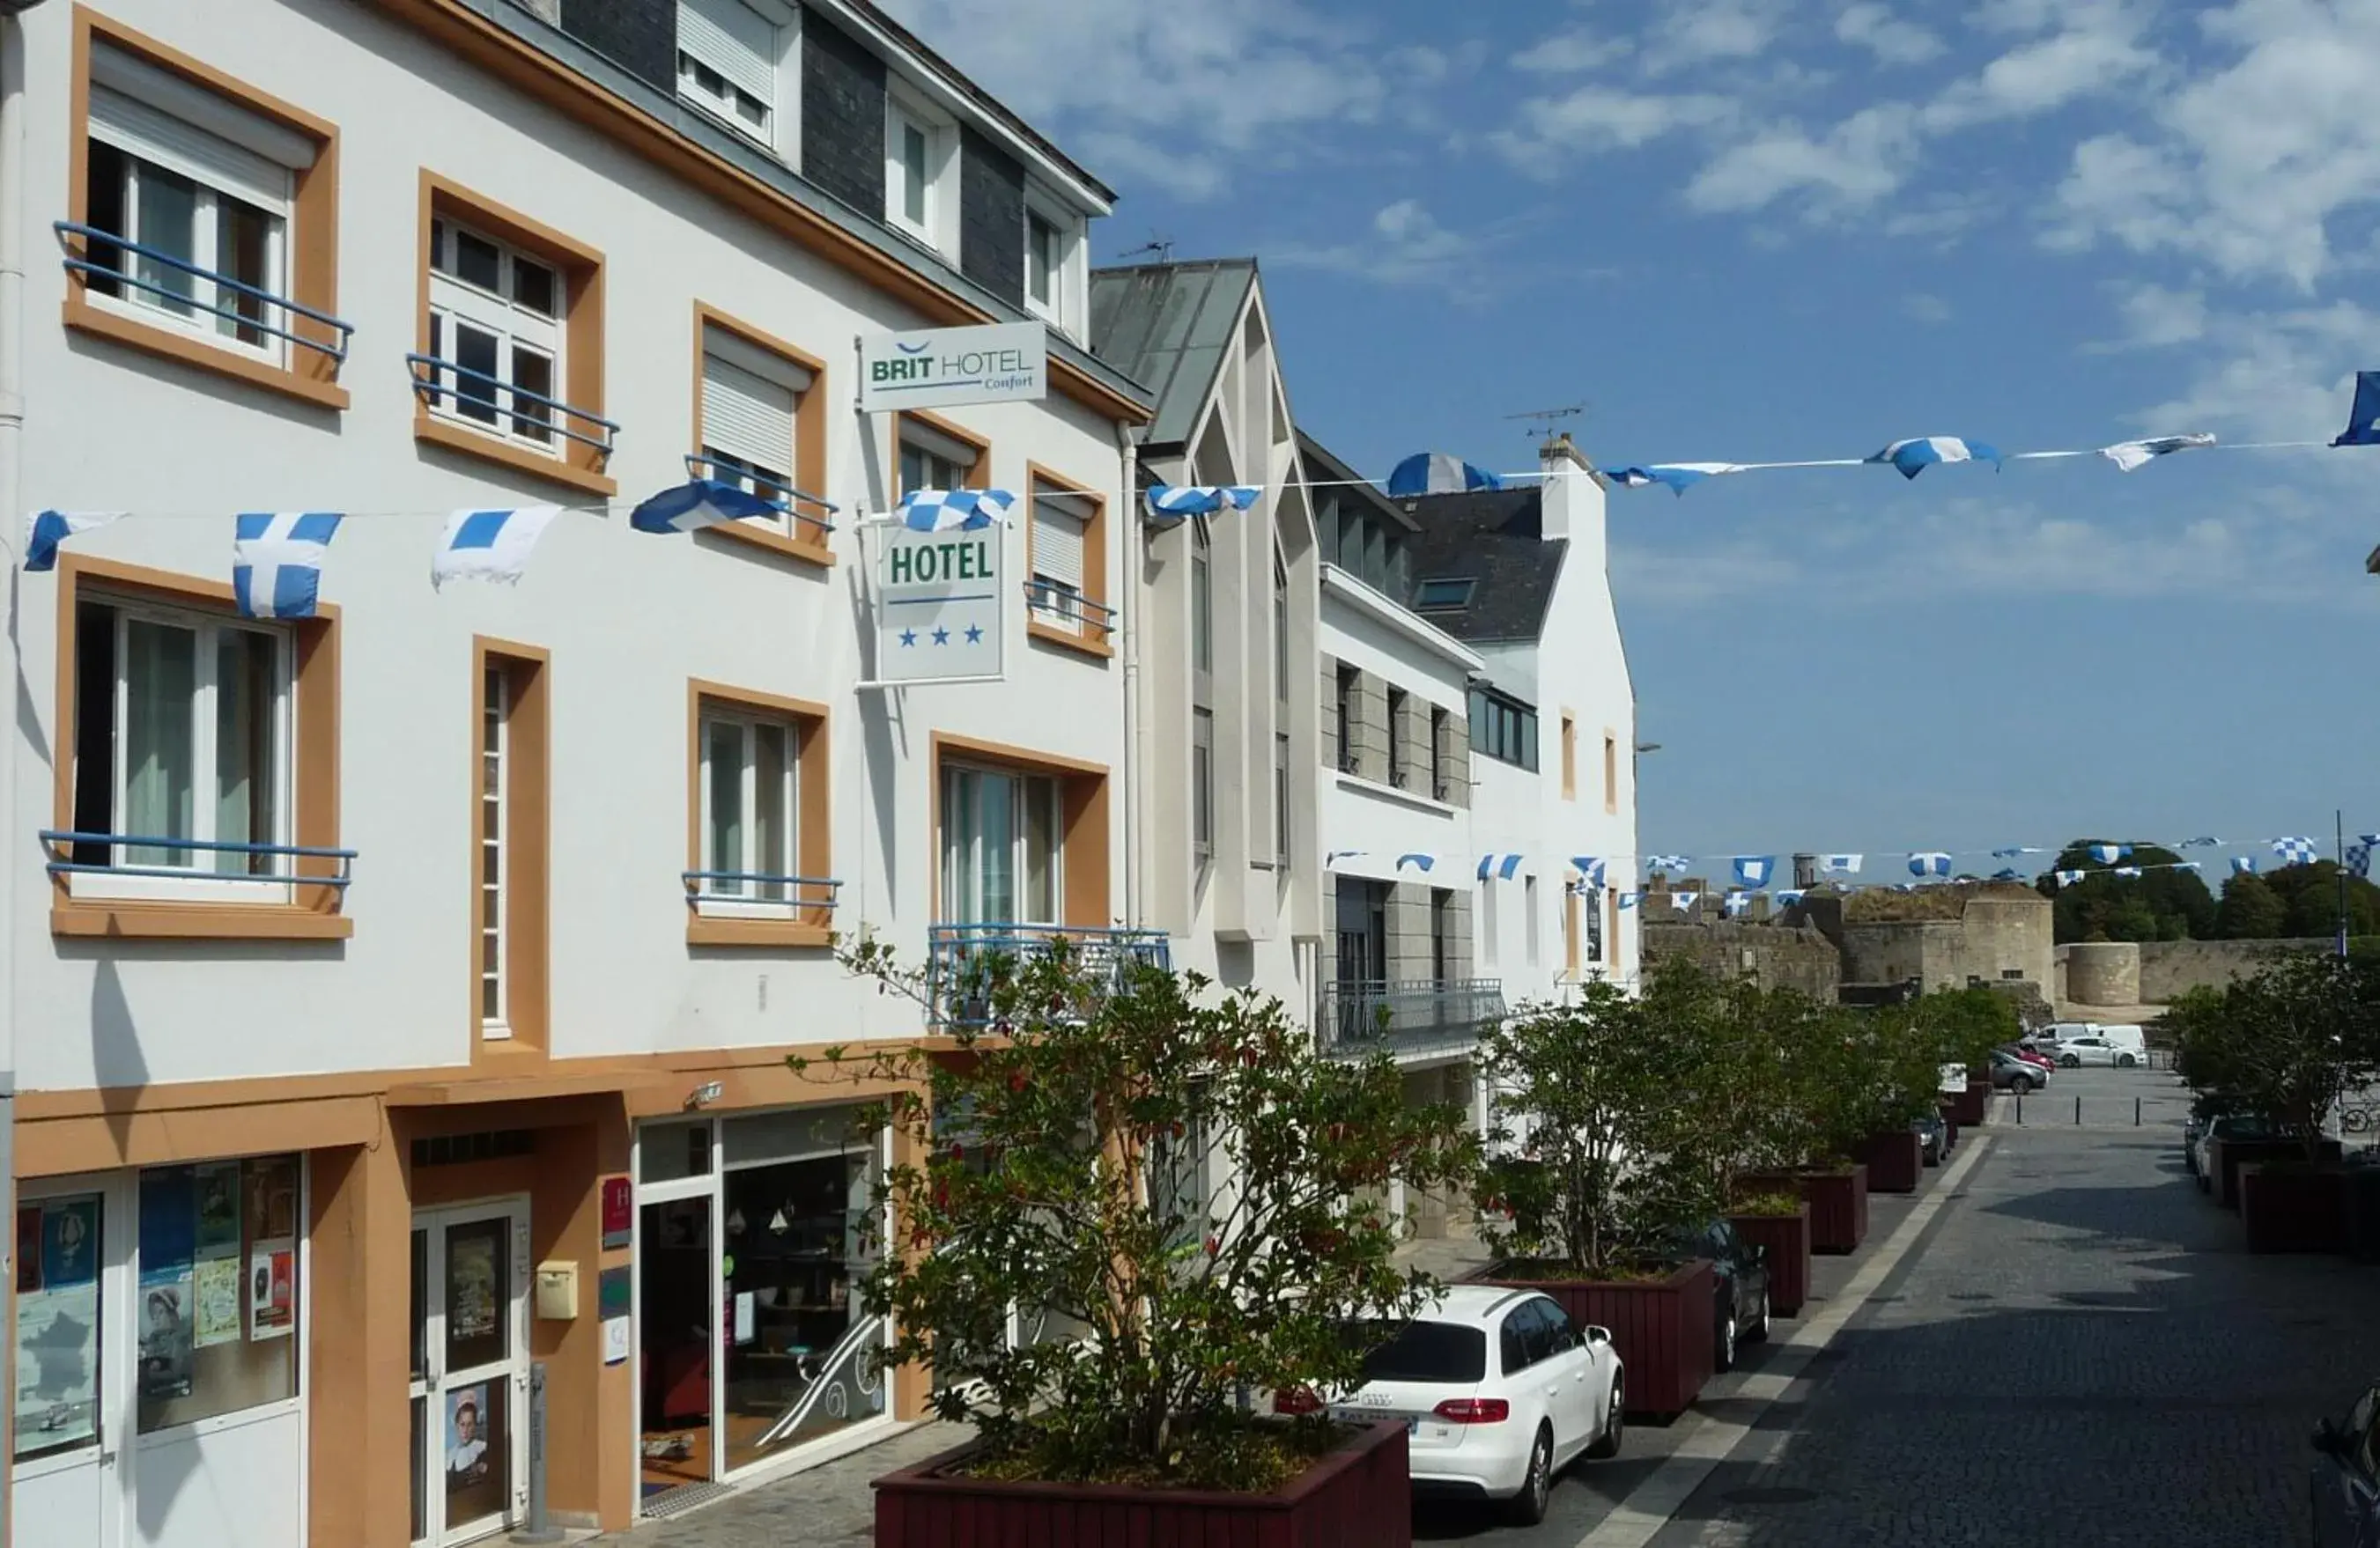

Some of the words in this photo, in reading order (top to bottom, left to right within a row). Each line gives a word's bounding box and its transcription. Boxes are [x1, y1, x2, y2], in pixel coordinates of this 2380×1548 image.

[872, 357, 934, 381] BRIT
[942, 350, 1034, 376] HOTEL
[985, 374, 1033, 391] Confort
[891, 542, 994, 584] HOTEL
[617, 1186, 629, 1206] H
